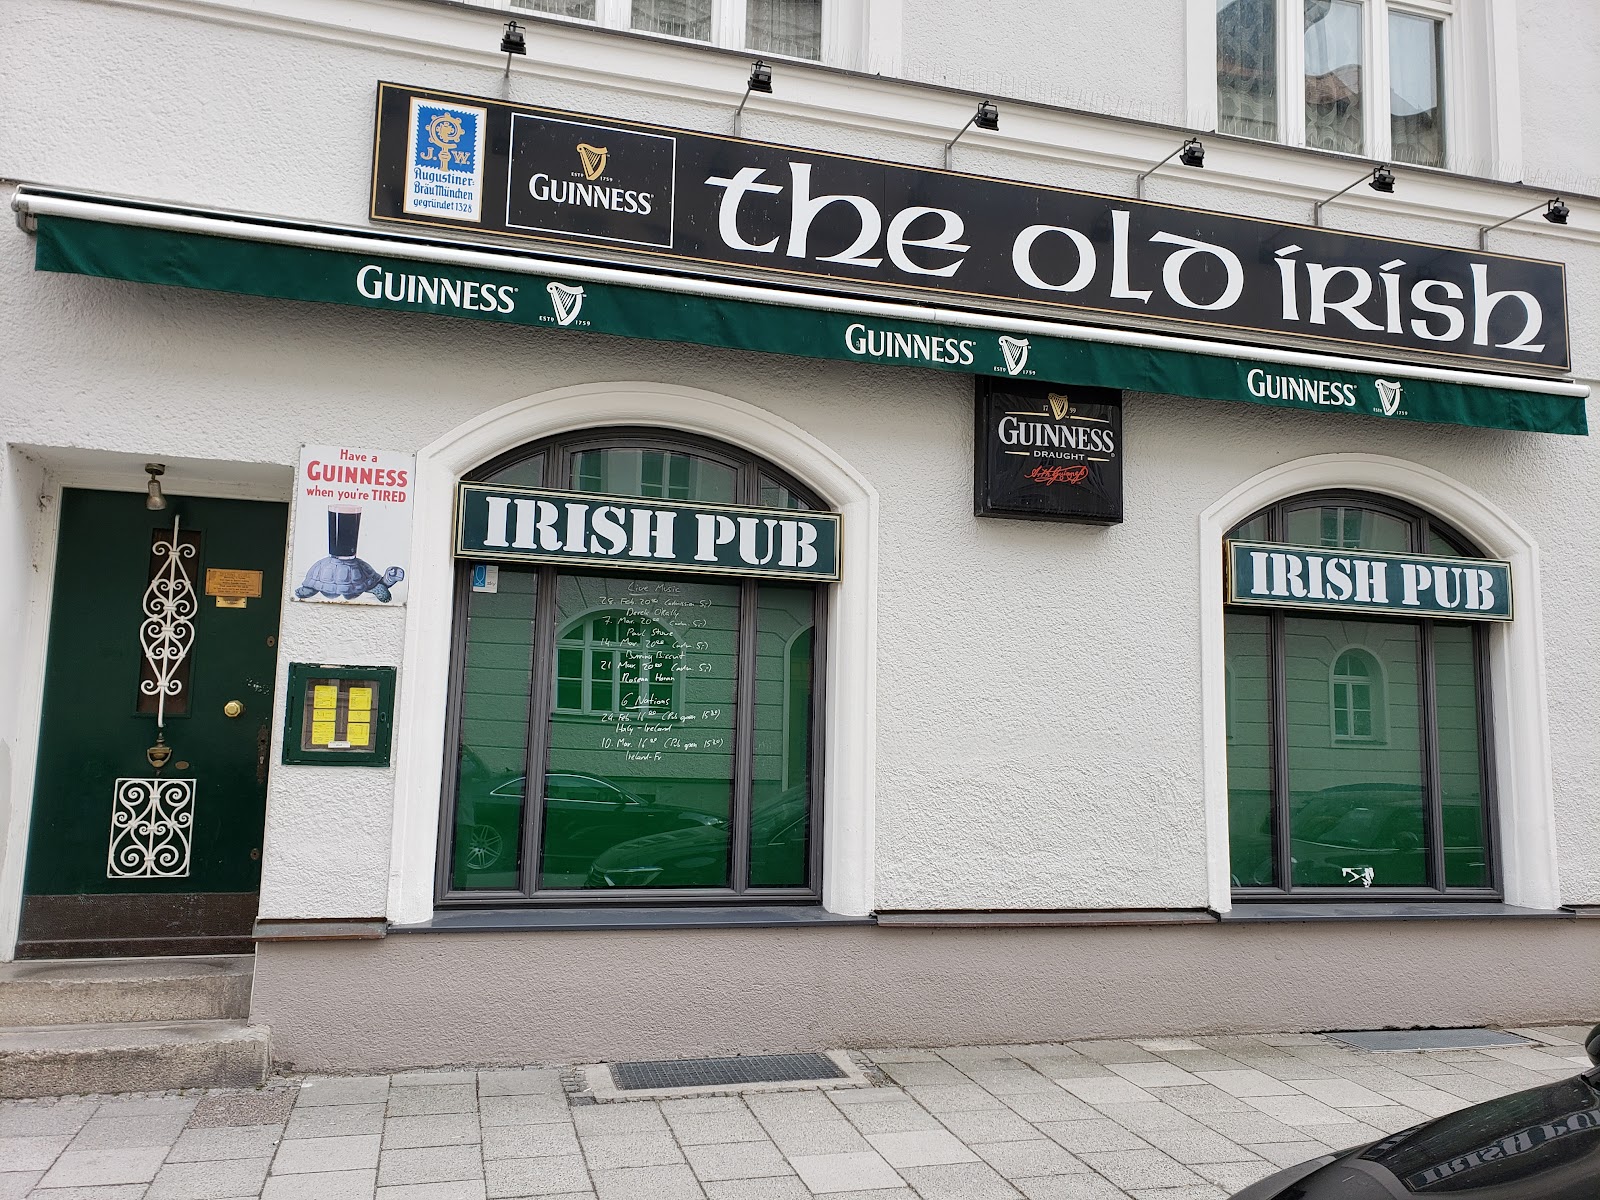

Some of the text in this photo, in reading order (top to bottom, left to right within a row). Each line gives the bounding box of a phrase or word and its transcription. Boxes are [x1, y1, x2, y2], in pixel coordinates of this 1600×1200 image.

[413, 198, 472, 213] gegründet 1328
[529, 173, 652, 215] GUINNESS
[704, 162, 972, 278] the
[356, 264, 515, 314] GUINNESS
[845, 323, 974, 365] GUINNESS
[1247, 368, 1356, 407] GUINNESS
[998, 416, 1114, 453] GUINNESS
[340, 449, 378, 463] Have a
[1034, 450, 1085, 461] DRAUGHT
[307, 460, 408, 488] GUINNESS
[306, 485, 407, 503] when you're TIRED
[483, 496, 818, 568] IRISH PUB
[628, 582, 681, 593] Live Music
[1250, 551, 1495, 610] IRISH PUB
[621, 692, 670, 706] 6 Nations
[644, 723, 672, 733] Ireland
